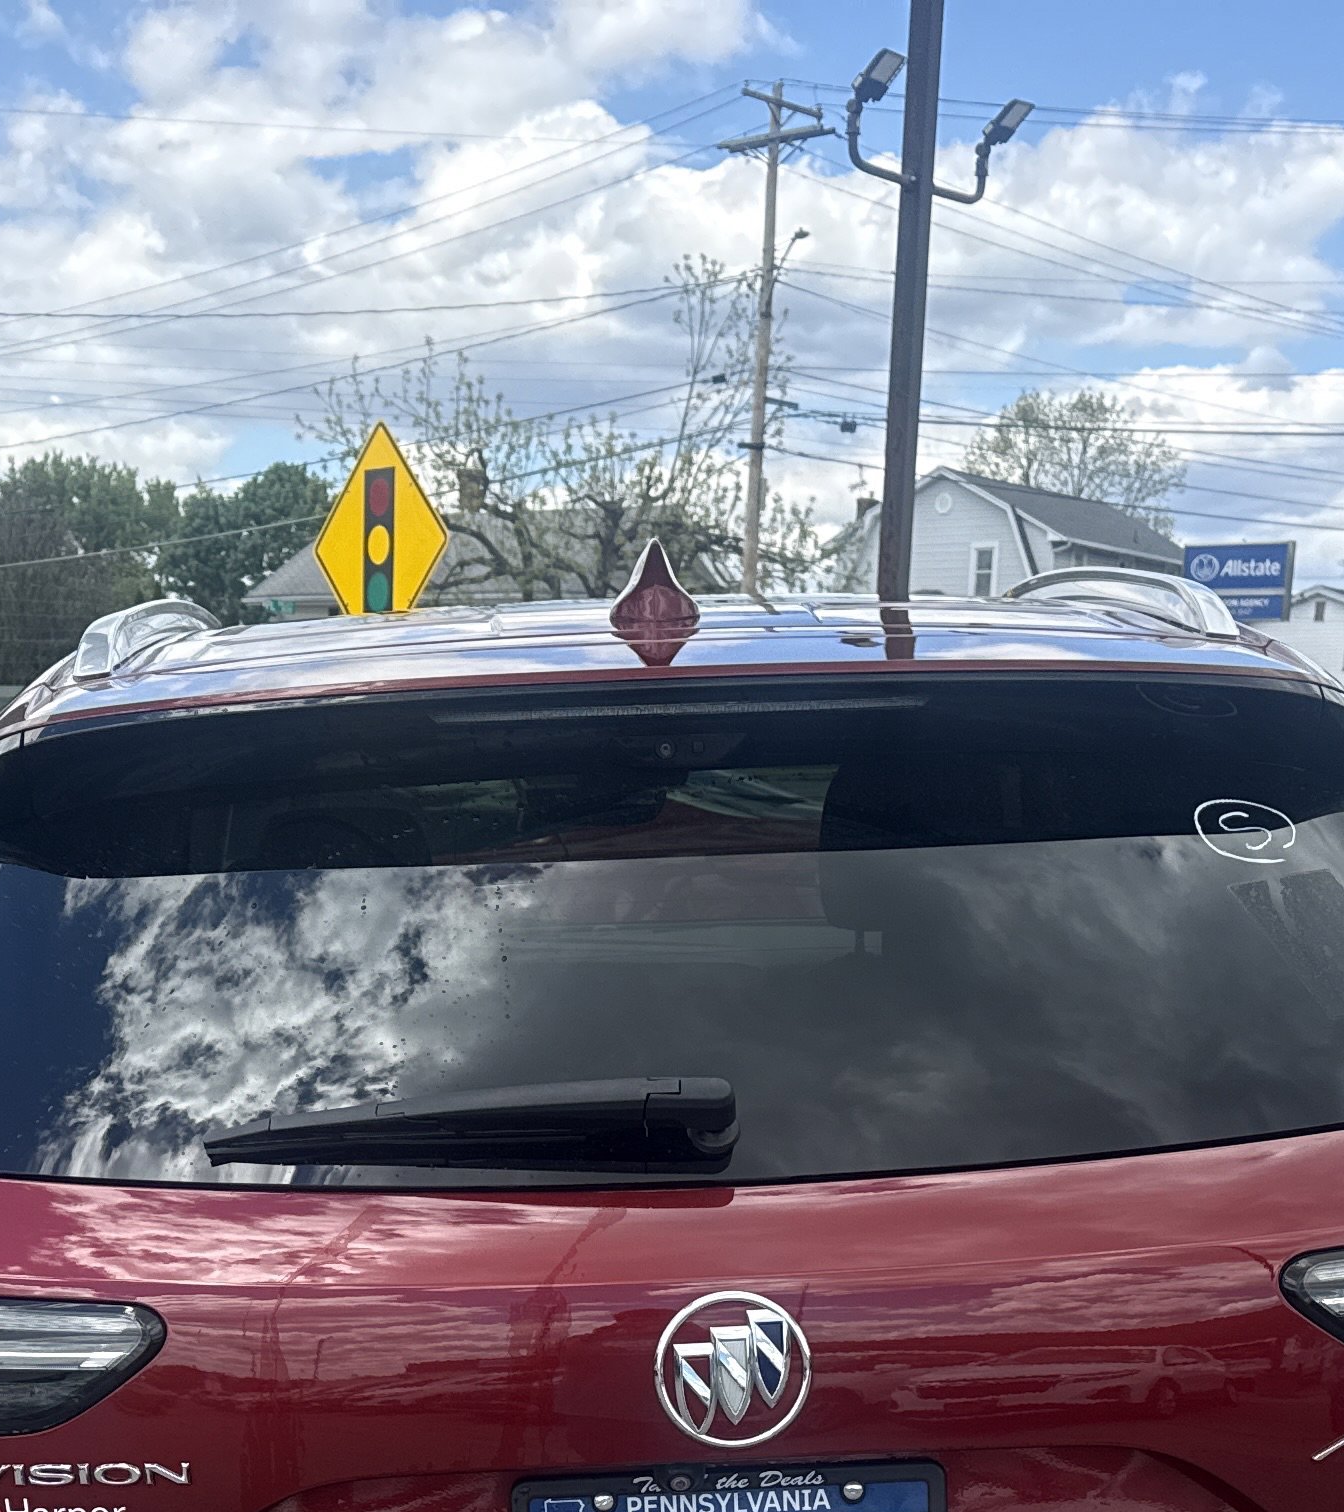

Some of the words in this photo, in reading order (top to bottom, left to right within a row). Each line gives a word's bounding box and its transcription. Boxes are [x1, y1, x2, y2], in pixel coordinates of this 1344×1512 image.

[1220, 558, 1281, 577] Allstate
[715, 1473, 750, 1490] the
[759, 1470, 825, 1488] Deals
